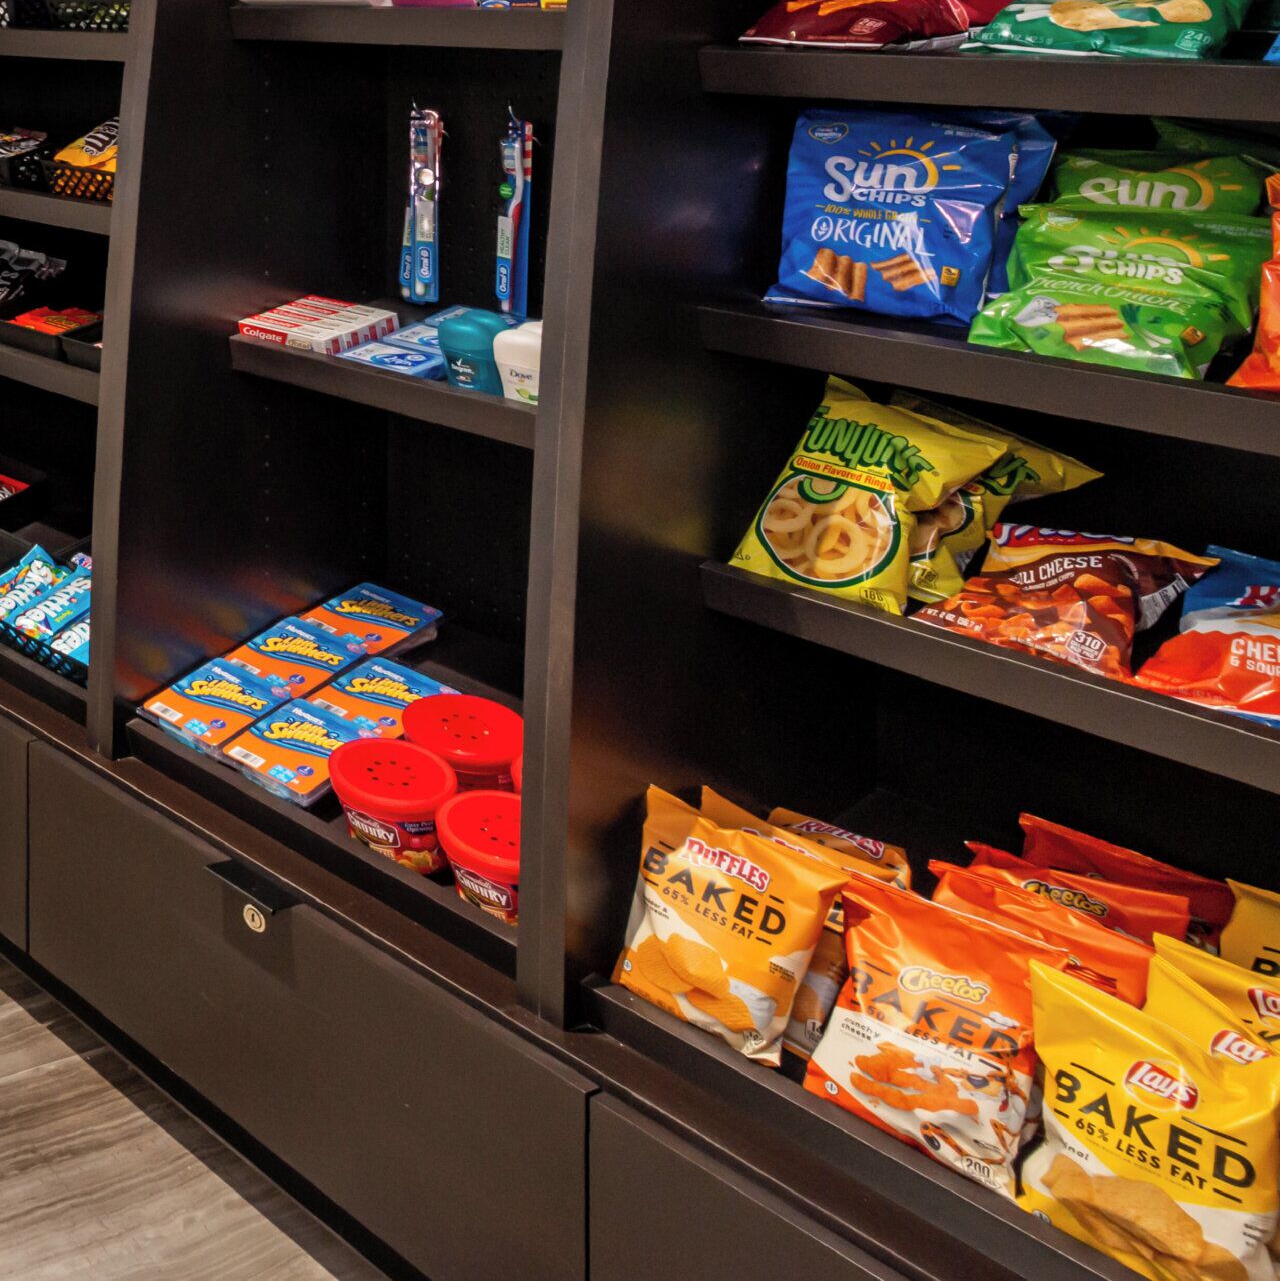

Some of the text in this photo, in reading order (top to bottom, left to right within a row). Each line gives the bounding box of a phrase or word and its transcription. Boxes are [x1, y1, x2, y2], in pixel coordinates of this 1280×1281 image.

[824, 156, 930, 202] Sun
[824, 204, 883, 220] 100% WHOLE
[851, 188, 927, 208] CHIPS
[811, 216, 936, 256] ORIGINAL
[1096, 259, 1184, 285] CHIPS
[242, 326, 283, 343] Colgate
[509, 368, 532, 381] Dove
[795, 457, 895, 492] Onion Flavored Rings
[1039, 555, 1103, 581] CHEESE
[260, 637, 344, 666] Swimmers
[1074, 632, 1101, 650] 310
[185, 680, 269, 710] Swimmers
[345, 678, 423, 704] Swimme
[263, 722, 346, 750] Swimmer
[347, 812, 395, 843] CHUNKY
[683, 837, 770, 892] RUFFLES
[455, 870, 507, 906] CHUNKY
[643, 847, 786, 936] BAKED
[662, 886, 754, 940] 65% LESS FAT
[899, 968, 989, 1003] Cheetos
[844, 1017, 881, 1038] crunchy
[851, 967, 1020, 1059] BAKED
[841, 1023, 872, 1041] cheese
[945, 1044, 974, 1061] FAT
[1055, 1069, 1257, 1189] BAKED
[1075, 1117, 1207, 1190] 65% LESS FAT
